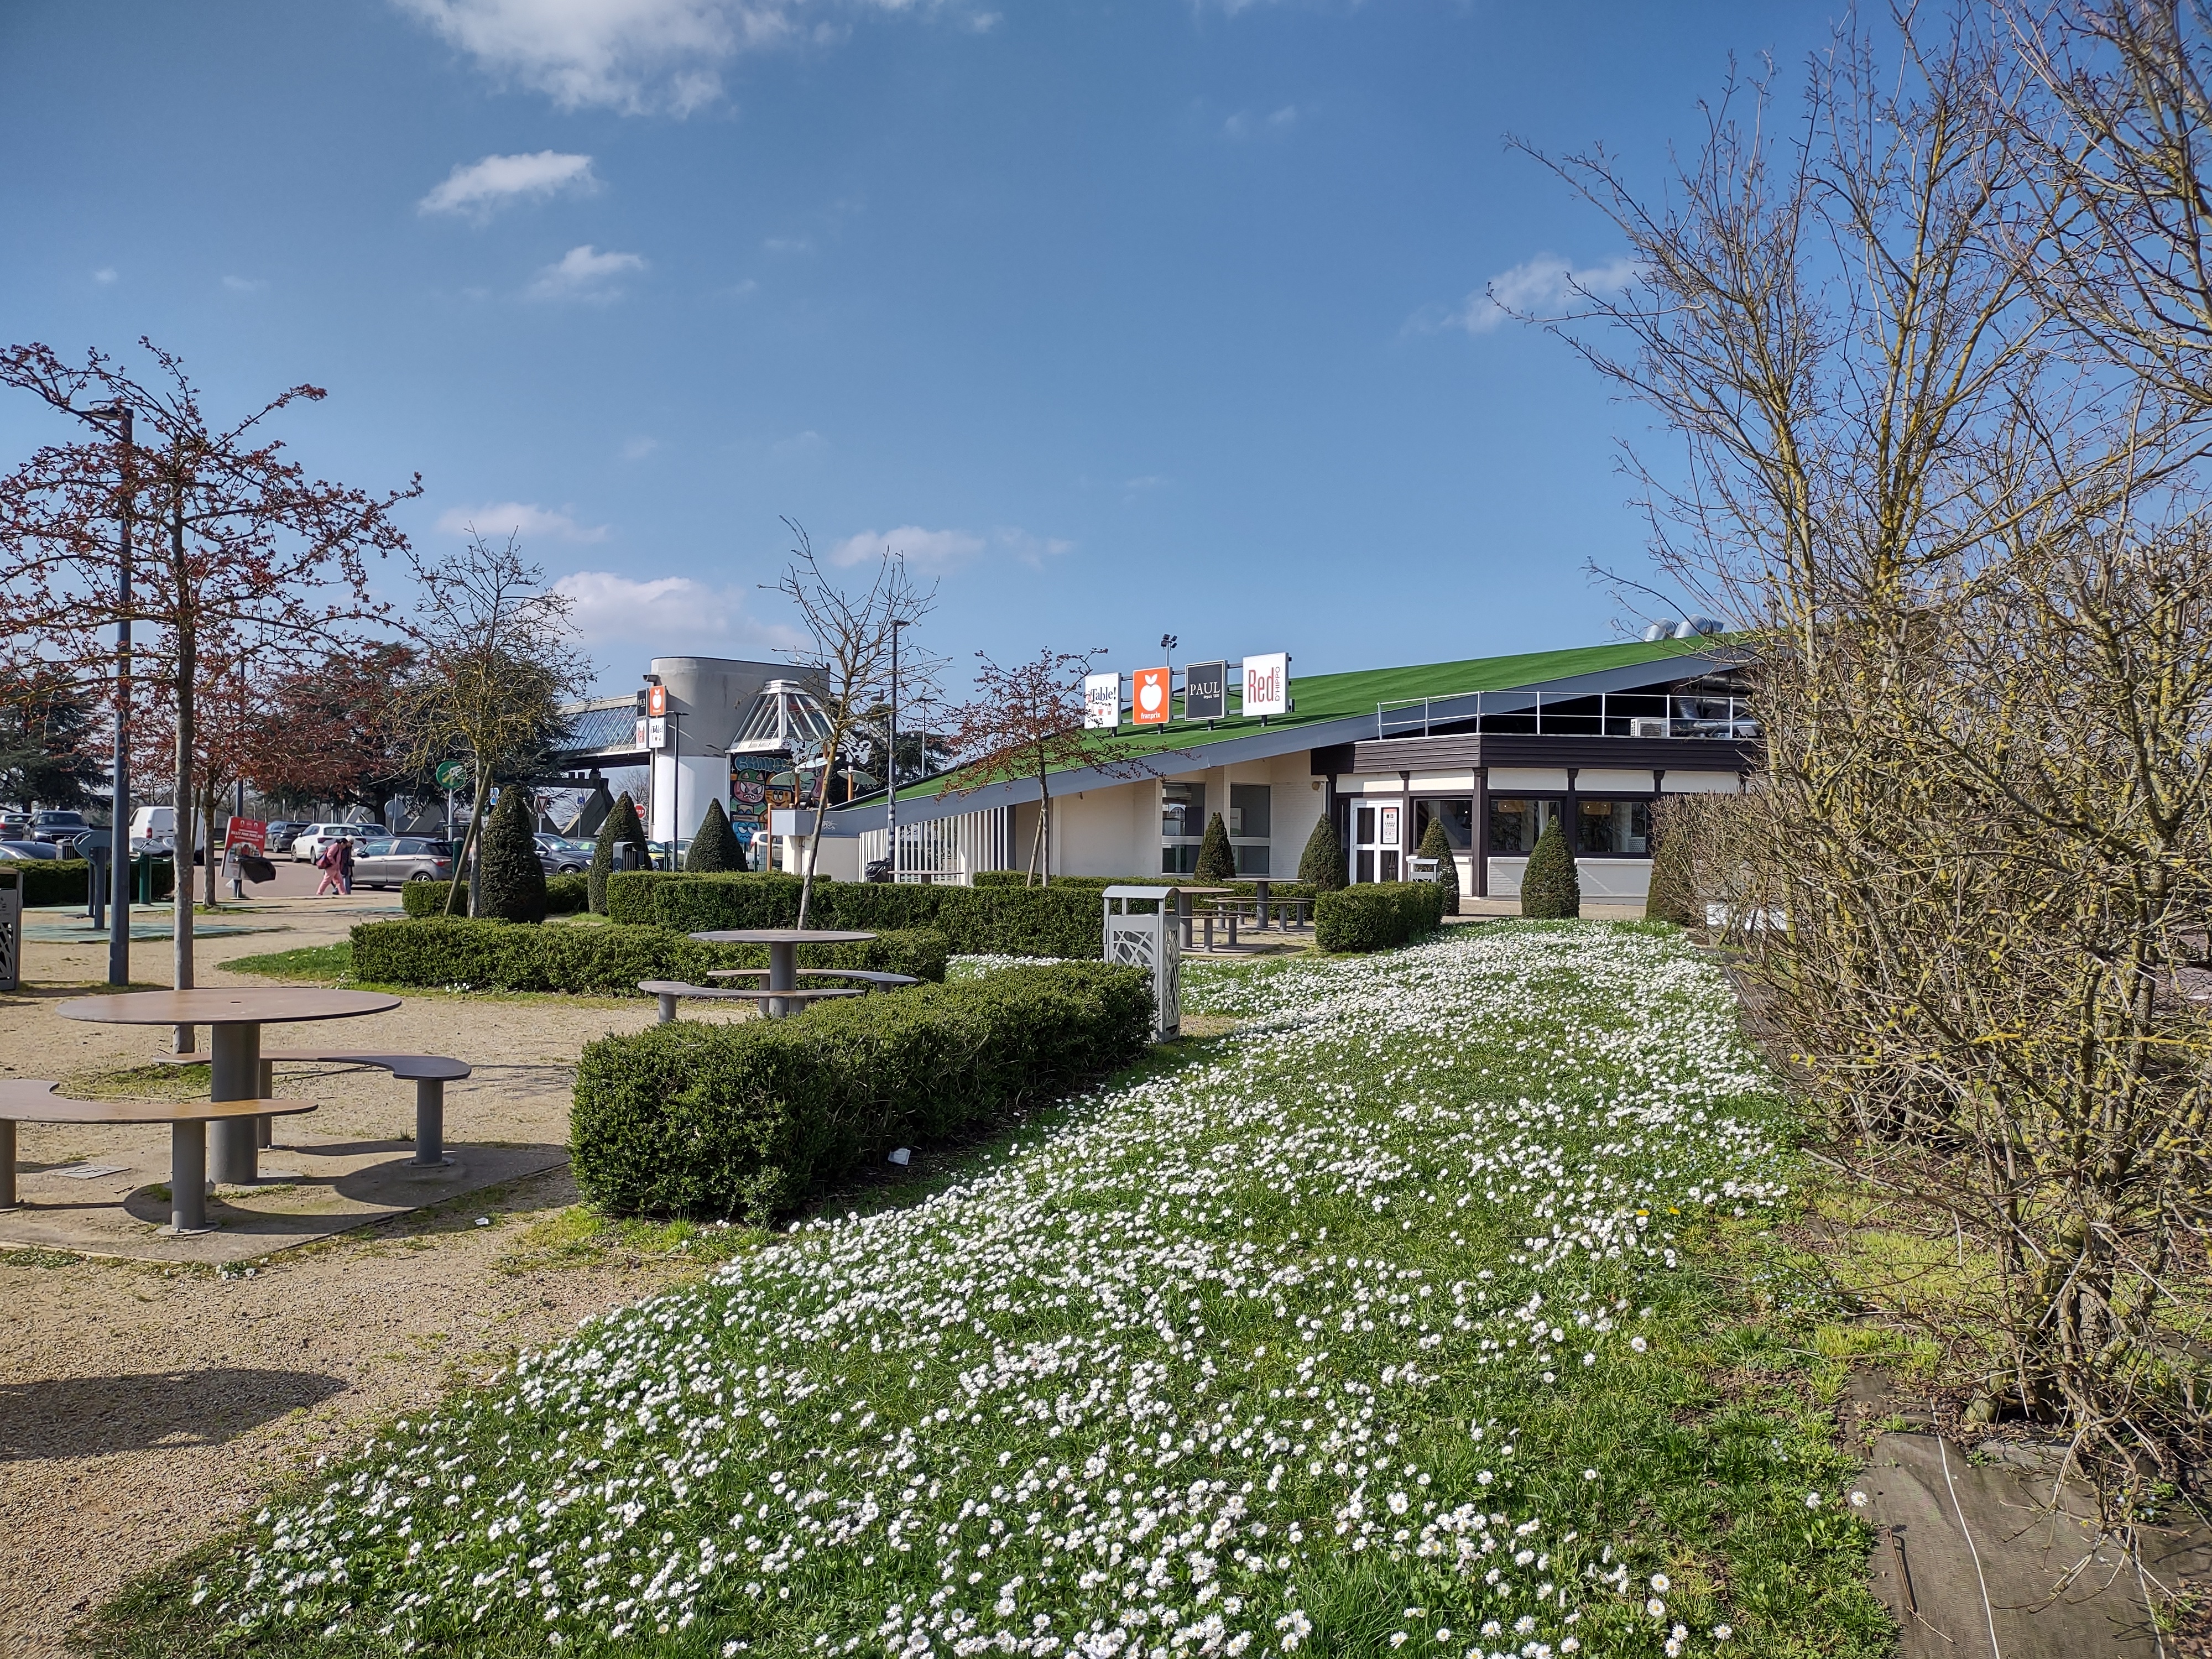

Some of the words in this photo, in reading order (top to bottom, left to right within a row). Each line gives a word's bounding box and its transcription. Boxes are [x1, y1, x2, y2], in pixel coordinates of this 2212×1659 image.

[1190, 682, 1220, 696] PAUL
[1249, 667, 1274, 703] Red
[1091, 686, 1117, 701] Table!
